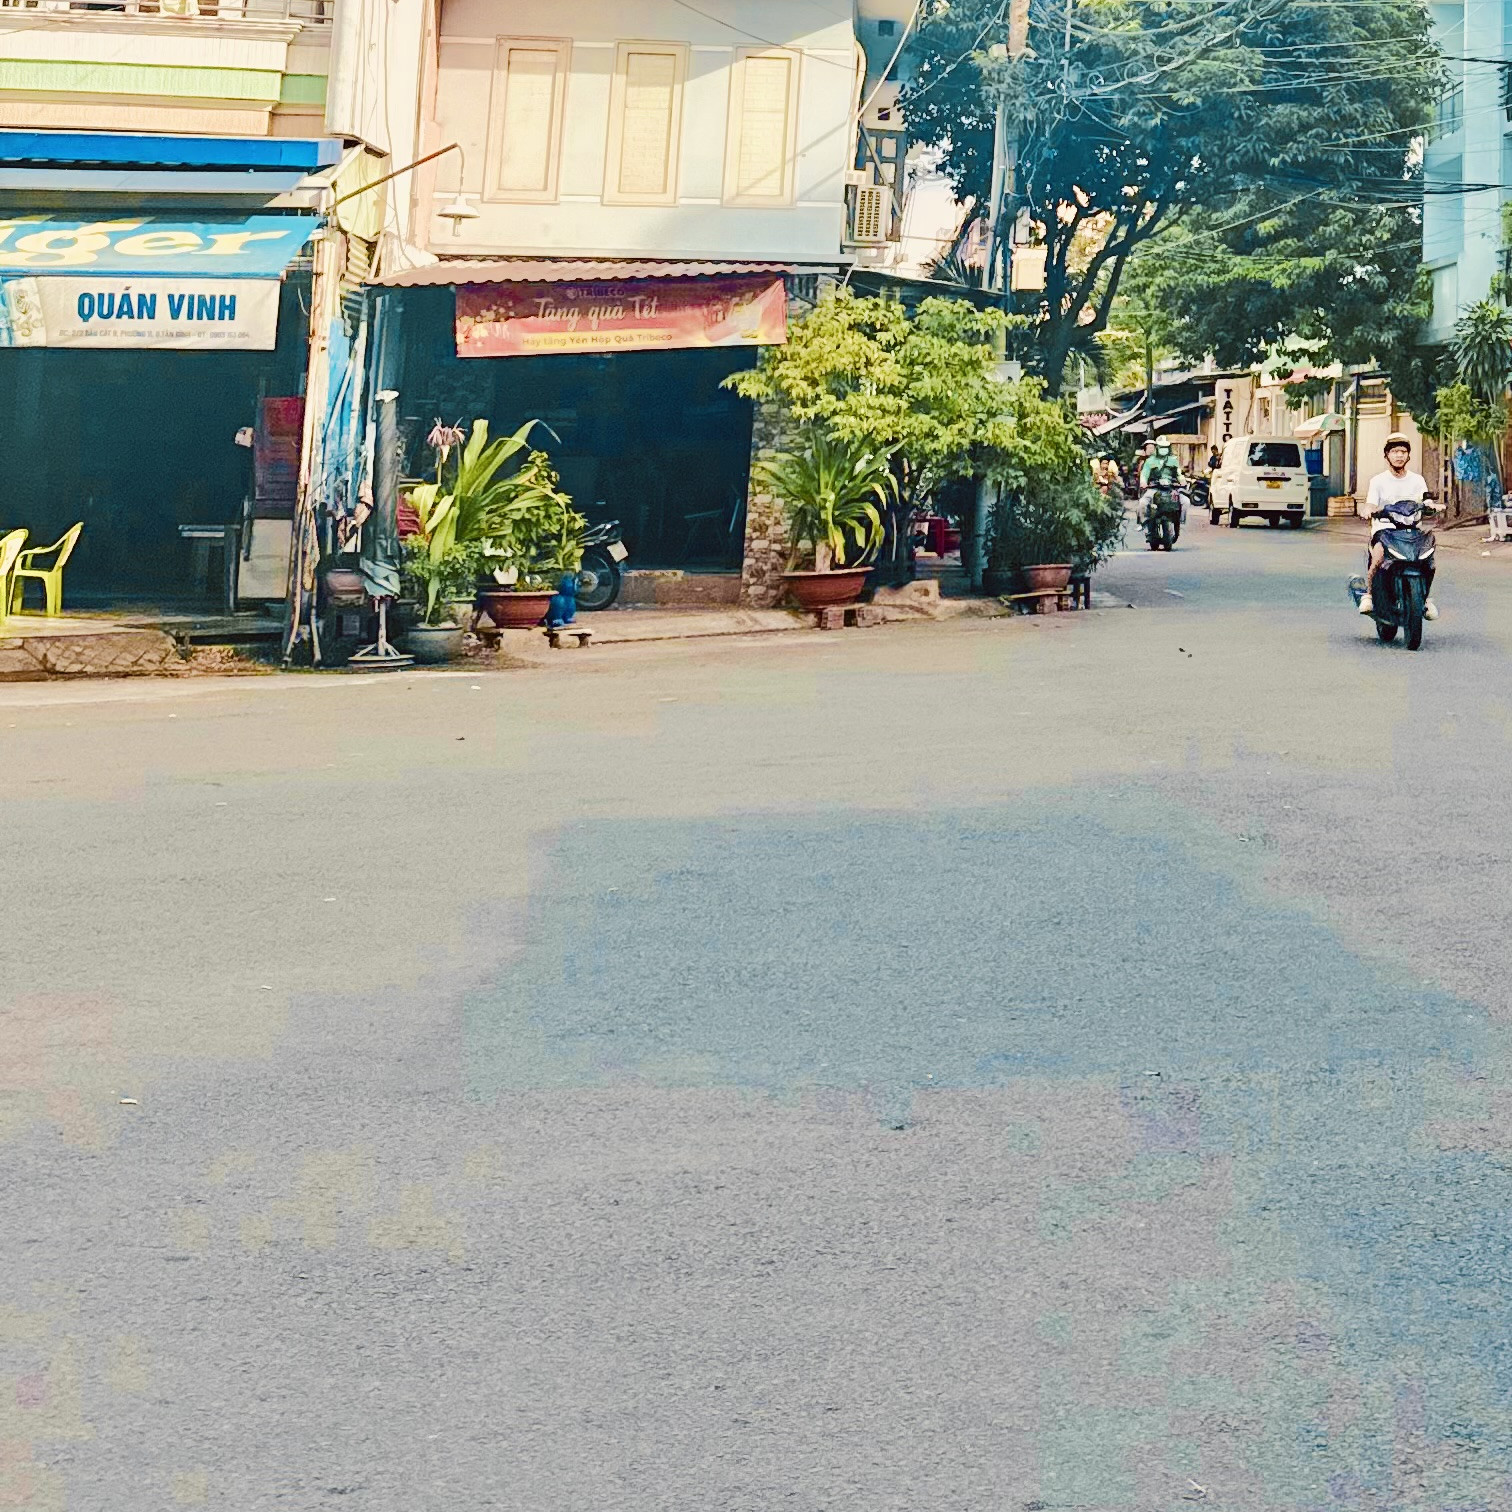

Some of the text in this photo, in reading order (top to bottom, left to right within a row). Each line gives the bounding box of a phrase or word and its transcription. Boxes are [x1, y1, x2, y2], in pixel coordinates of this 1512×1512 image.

[578, 288, 625, 298] TRIBECO
[77, 286, 237, 322] QUÁN VINH
[637, 333, 673, 342] Tribeco
